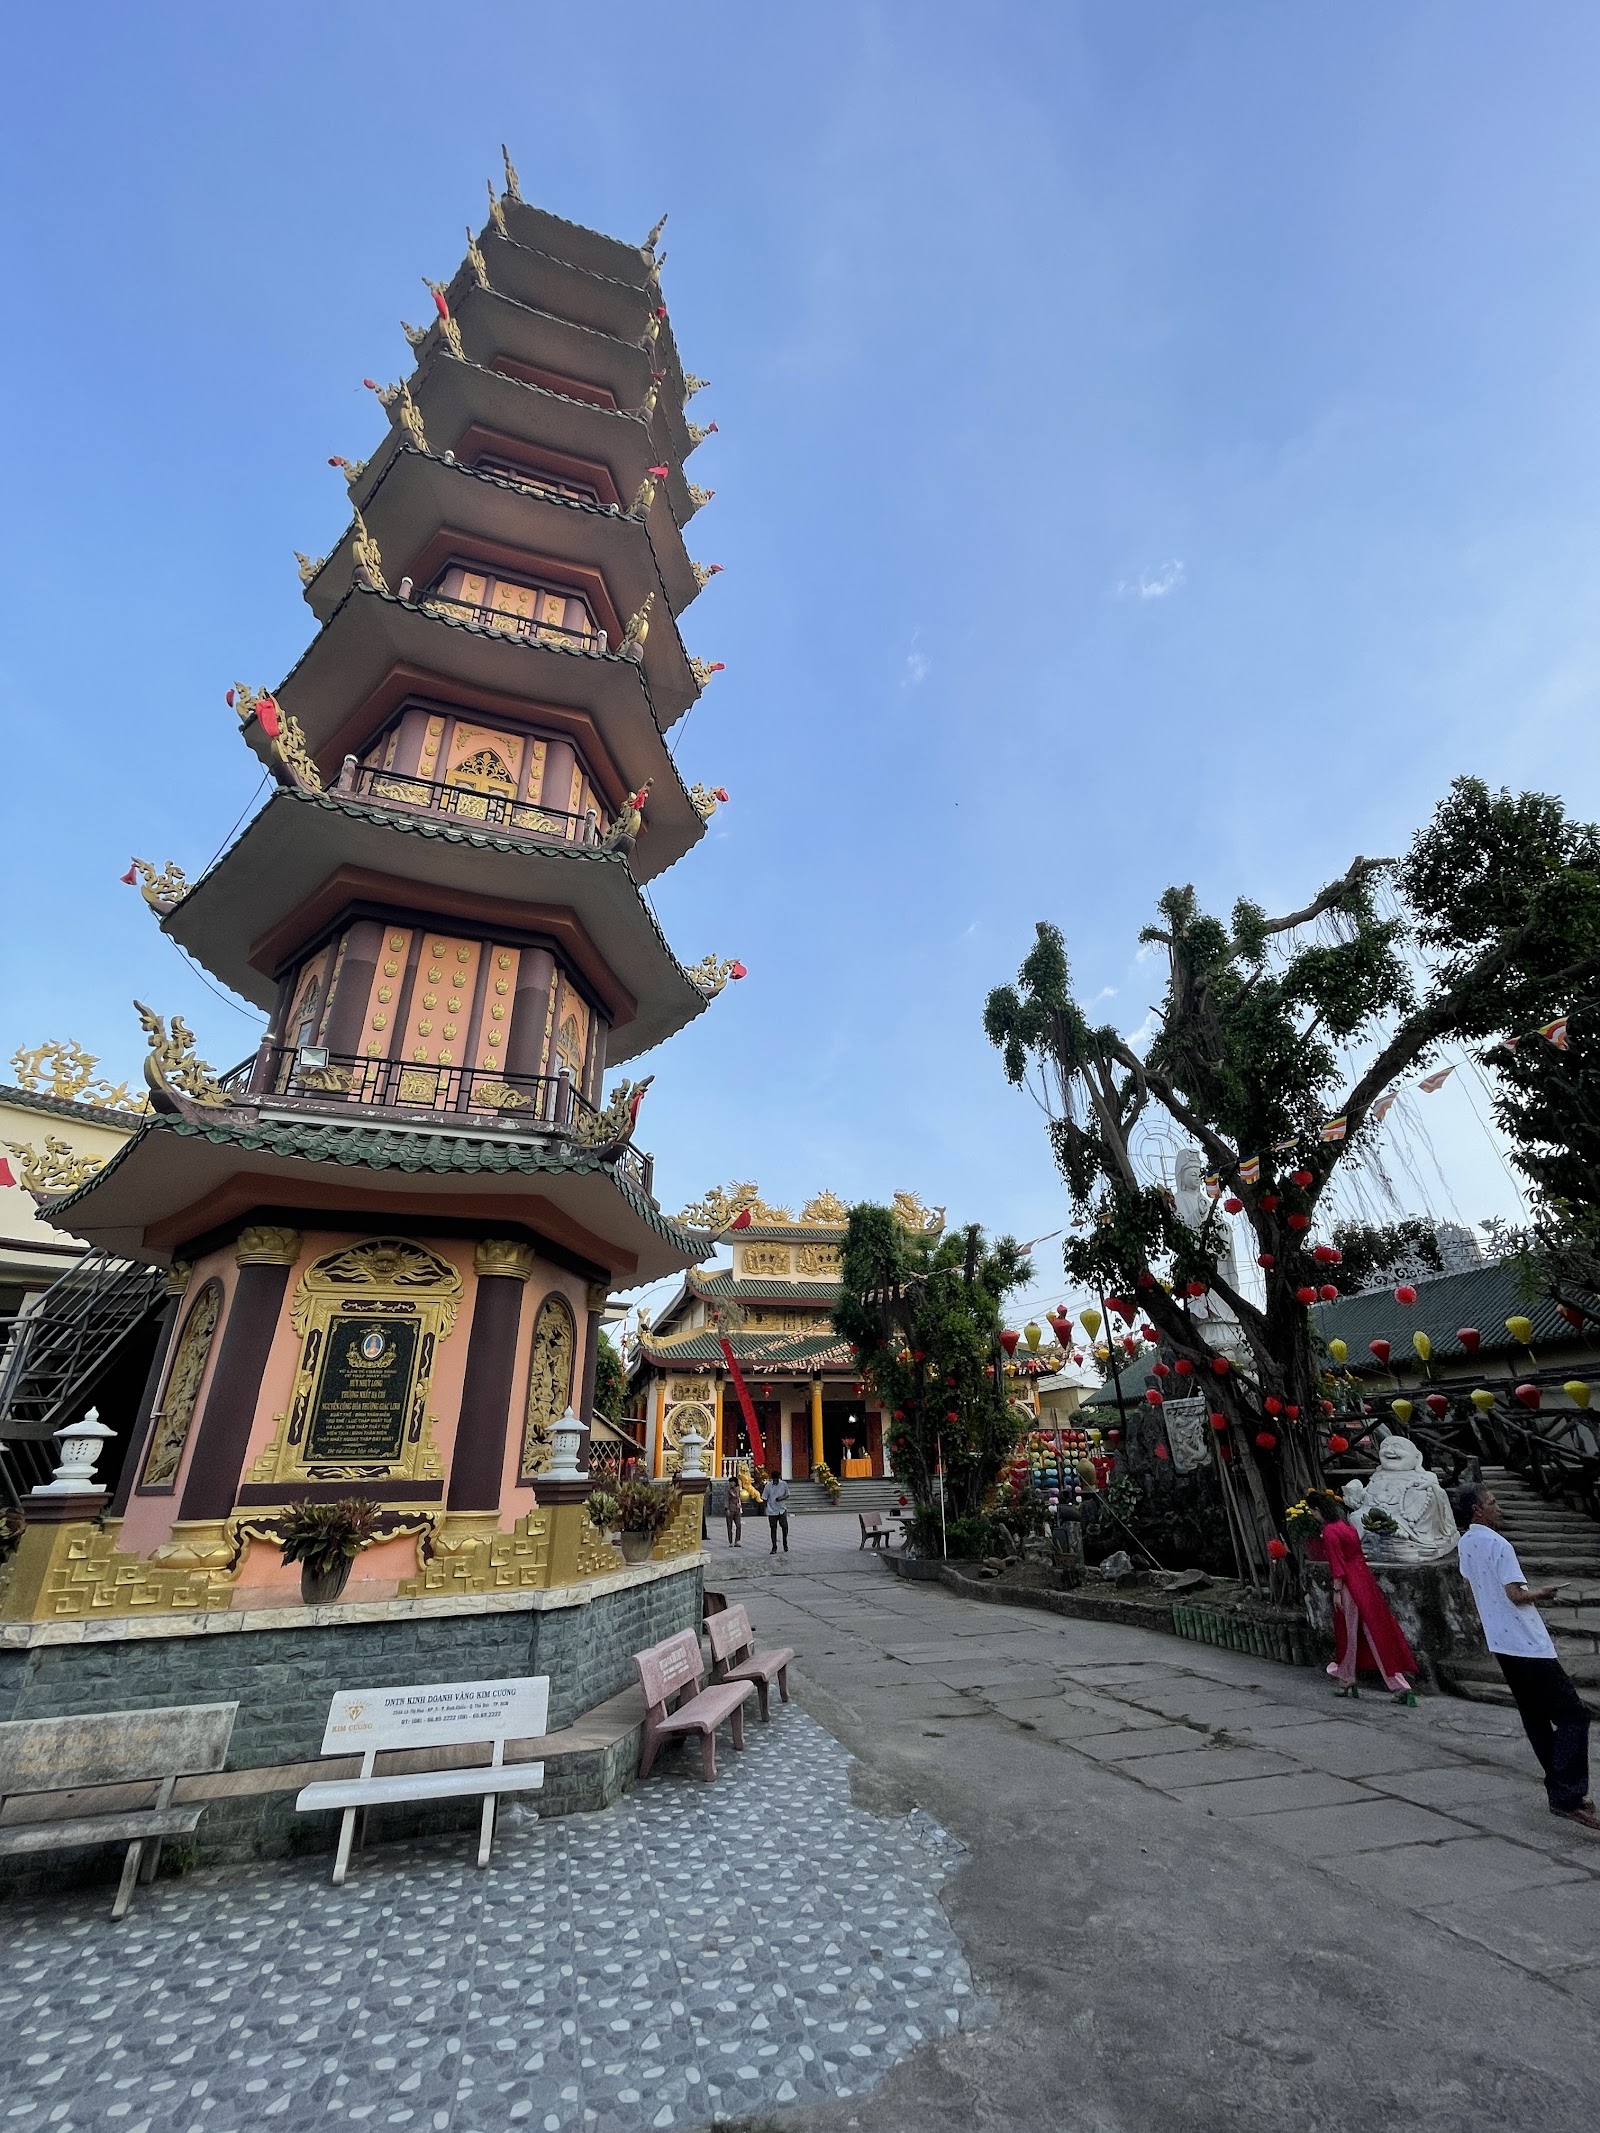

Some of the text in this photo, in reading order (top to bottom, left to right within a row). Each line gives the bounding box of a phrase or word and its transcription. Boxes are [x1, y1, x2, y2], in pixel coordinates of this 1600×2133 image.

[384, 1698, 406, 1707] DNTN
[407, 1696, 426, 1705] KINH
[427, 1693, 453, 1703] DOANH
[476, 1690, 491, 1699] KIM
